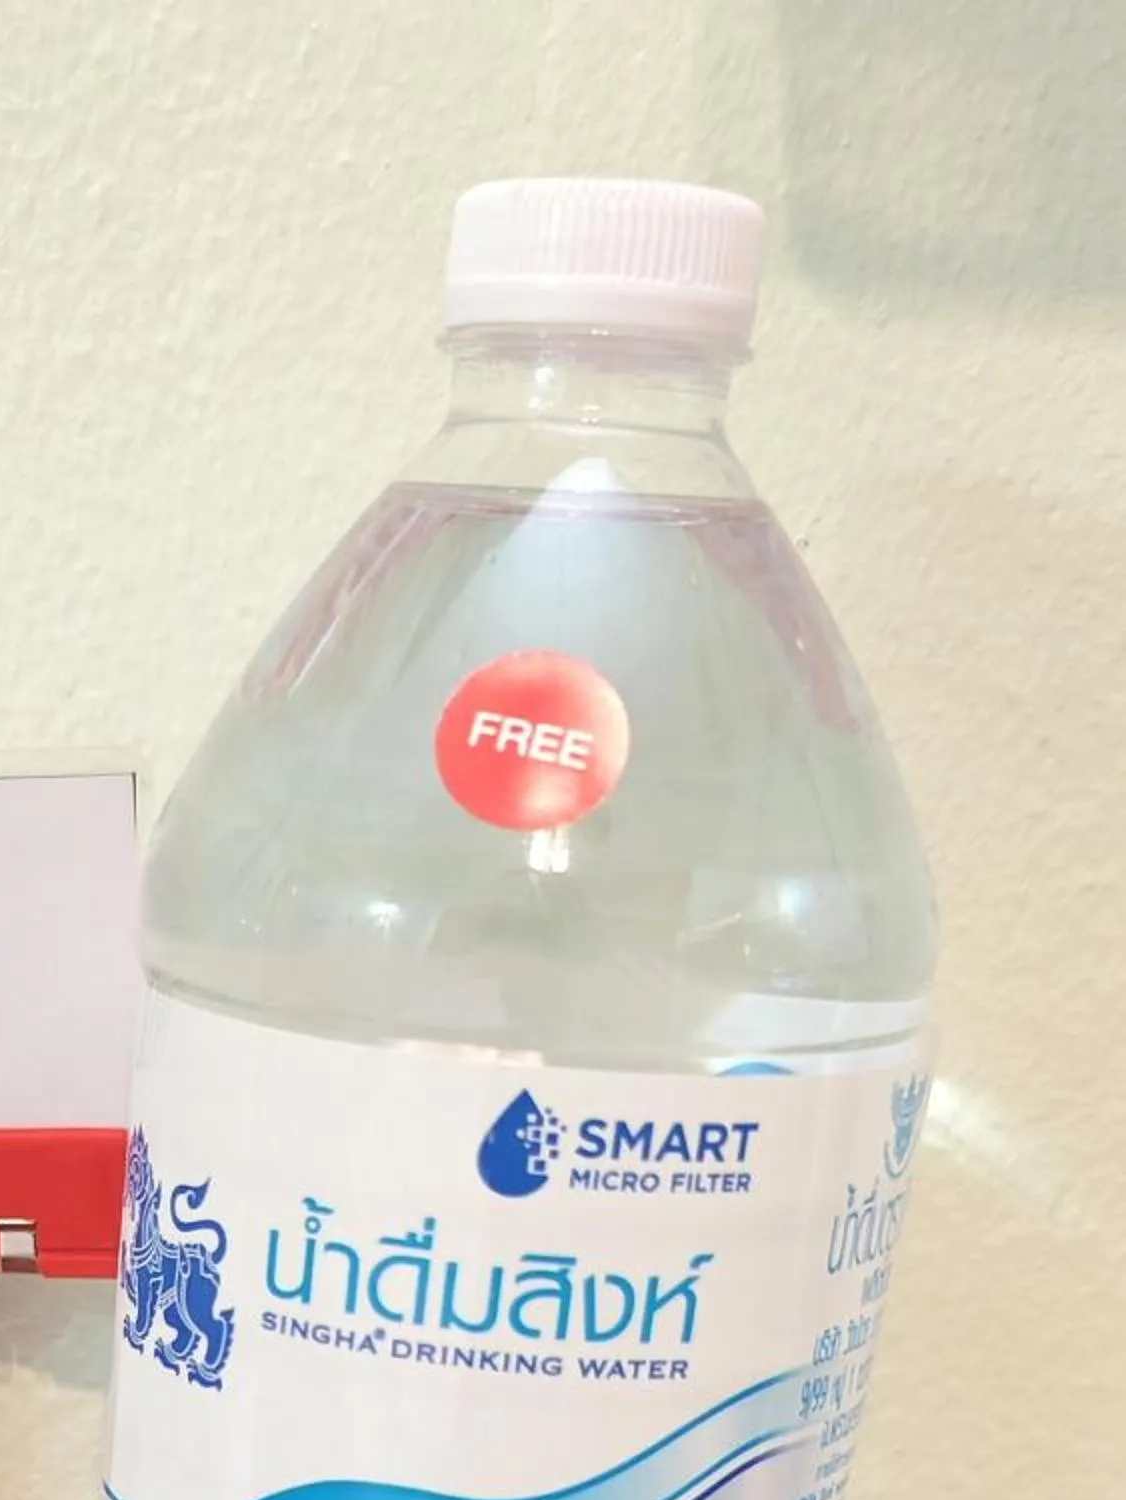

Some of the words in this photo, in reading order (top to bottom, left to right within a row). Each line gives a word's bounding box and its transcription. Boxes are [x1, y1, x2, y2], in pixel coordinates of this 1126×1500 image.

[467, 711, 595, 771] FREE
[574, 1119, 759, 1165] SMART
[569, 1169, 662, 1194] MICRO
[669, 1170, 752, 1194] FILTER
[265, 1197, 715, 1346] น้ำดื่มสิงห์
[390, 1338, 564, 1378] DRINKING
[579, 1357, 690, 1381] WATER
